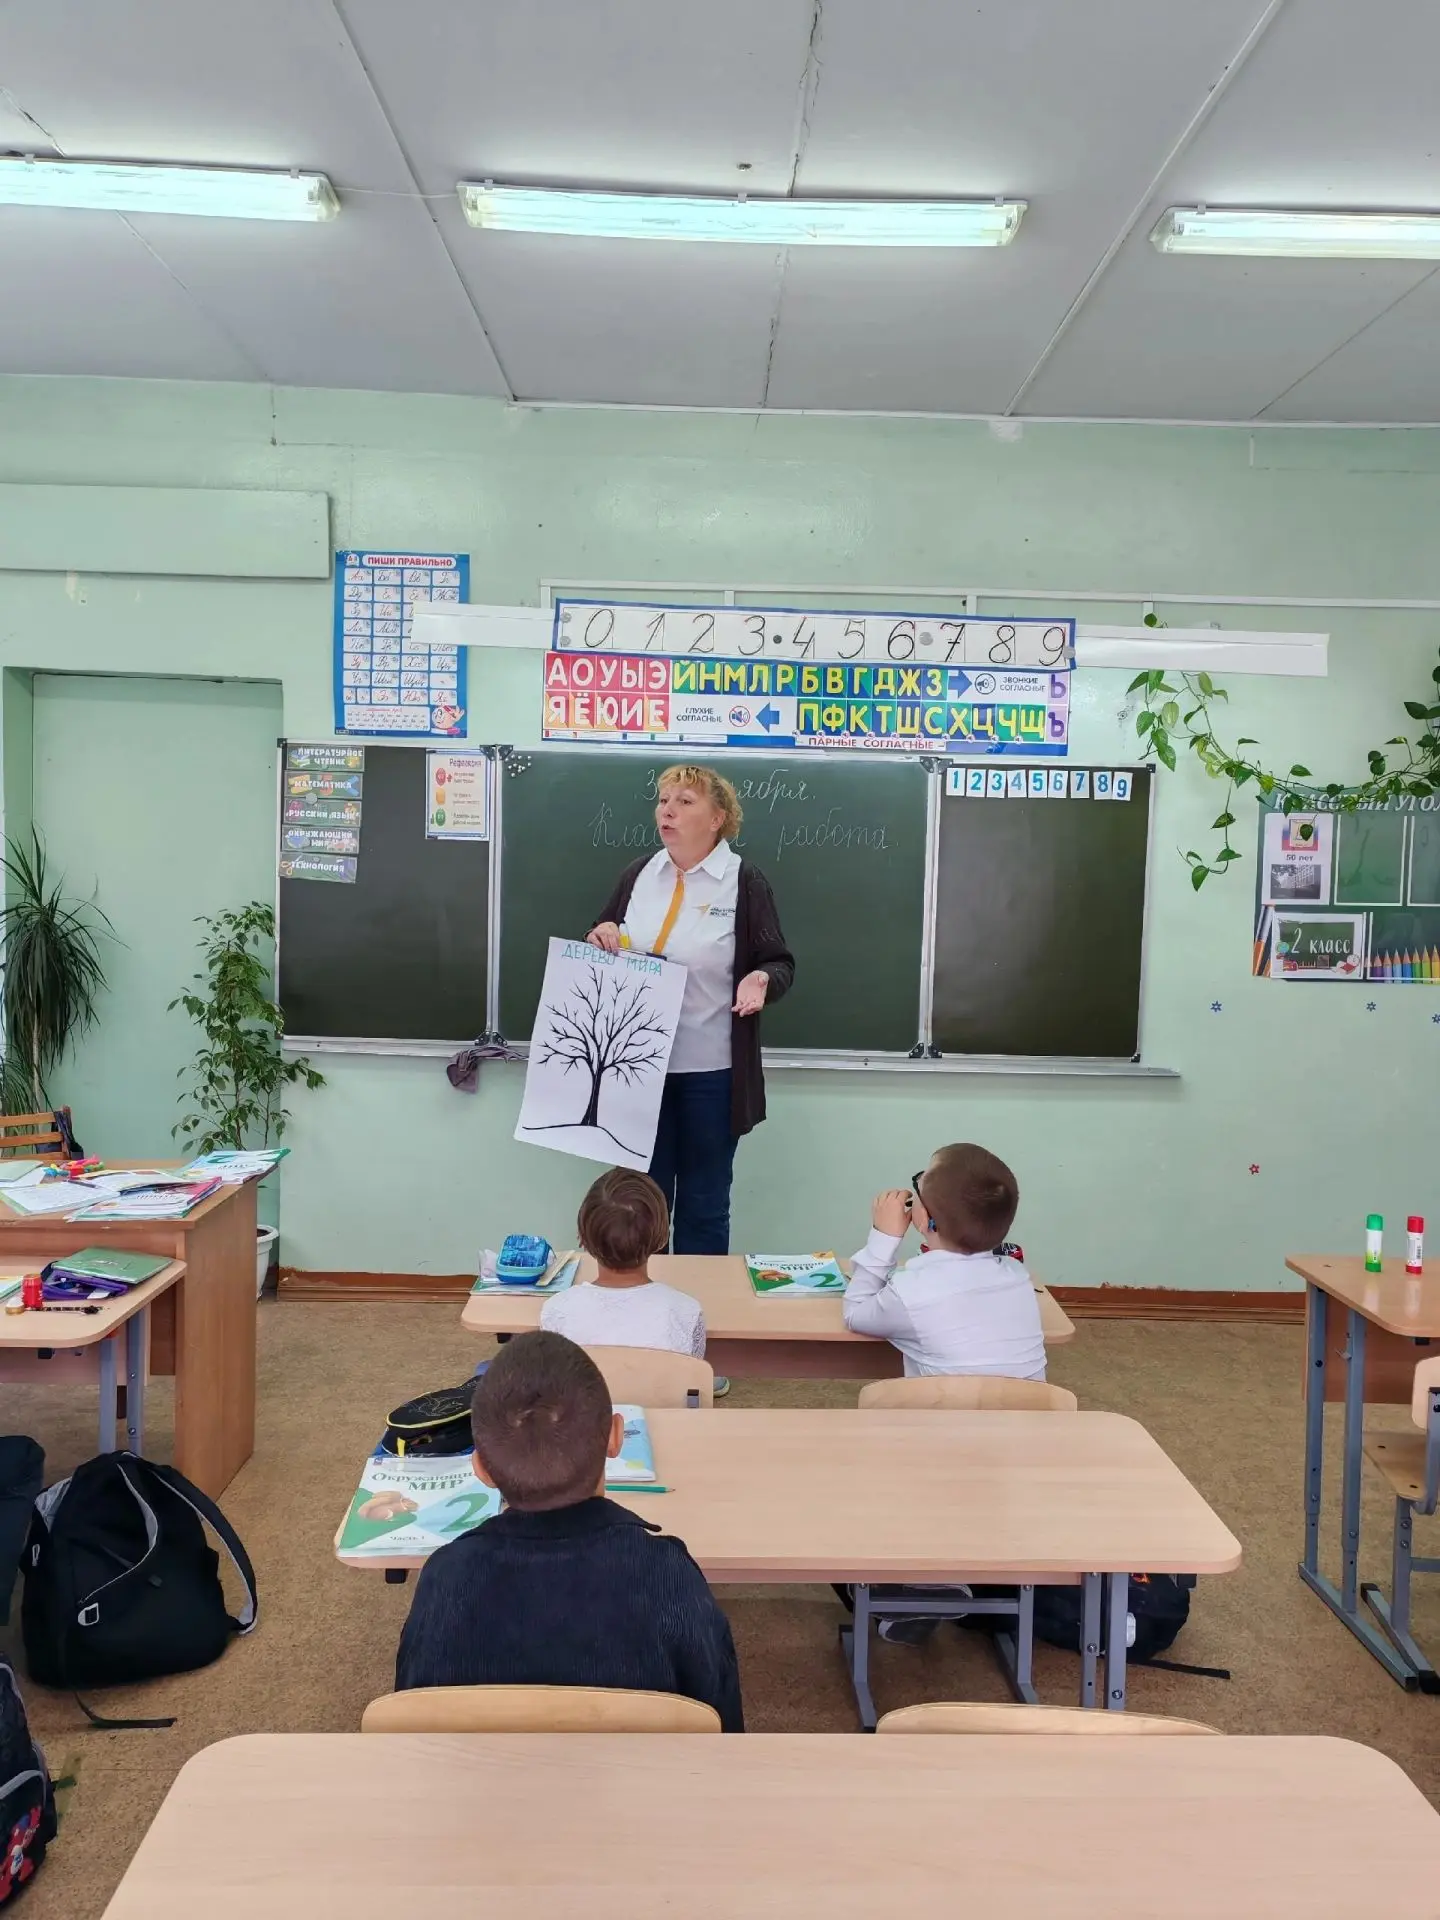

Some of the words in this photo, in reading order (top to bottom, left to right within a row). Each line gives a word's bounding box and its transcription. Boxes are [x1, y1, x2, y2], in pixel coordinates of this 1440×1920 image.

[368, 556, 395, 565] ПИШИ
[398, 557, 453, 567] ПРАВИЛЬНО
[584, 609, 614, 647] 0
[645, 612, 665, 650] 1
[688, 613, 714, 653] 2
[738, 615, 765, 655] 3
[792, 616, 815, 658] 4
[837, 619, 865, 659] 5
[888, 620, 915, 660] 6
[940, 622, 965, 662] 7
[989, 625, 1016, 663] 8
[1039, 626, 1065, 666] 9
[1003, 676, 1039, 685] ЗВОНКИЕ
[1051, 674, 1066, 698] Ь
[1000, 684, 1047, 693] СОГЛАСНЫЕ
[685, 707, 714, 715] ГЛУХИЕ
[676, 714, 723, 723] СОГЛАСНЫЕ
[1048, 711, 1064, 738] Ъ
[808, 737, 857, 747] ПАРНЫЕ
[864, 739, 934, 750] СОГЛАСНЫЕ
[298, 747, 363, 757] ЛИТЕРАТУРНОЕ
[294, 780, 352, 789] МАТЕМАТИКА
[954, 770, 959, 789] 1
[971, 772, 983, 791] 2
[991, 773, 1002, 791] 3
[1011, 773, 1022, 790] 4
[1033, 773, 1043, 792] 5
[1053, 773, 1063, 791] 6
[1076, 773, 1085, 791] 7
[1098, 774, 1108, 793] 8
[1117, 779, 1127, 798] 9
[288, 809, 328, 818] РУССКИЙ
[288, 830, 353, 839] ОКРУЖАЮЩИЙ
[291, 861, 345, 873] ТЕХНОЛОГИЯ
[1291, 927, 1302, 954] 2
[1309, 939, 1350, 954] класс
[627, 956, 662, 977] МИРА
[809, 1273, 843, 1288] 2
[408, 1479, 464, 1491] МИР
[439, 1492, 492, 1533] 2
